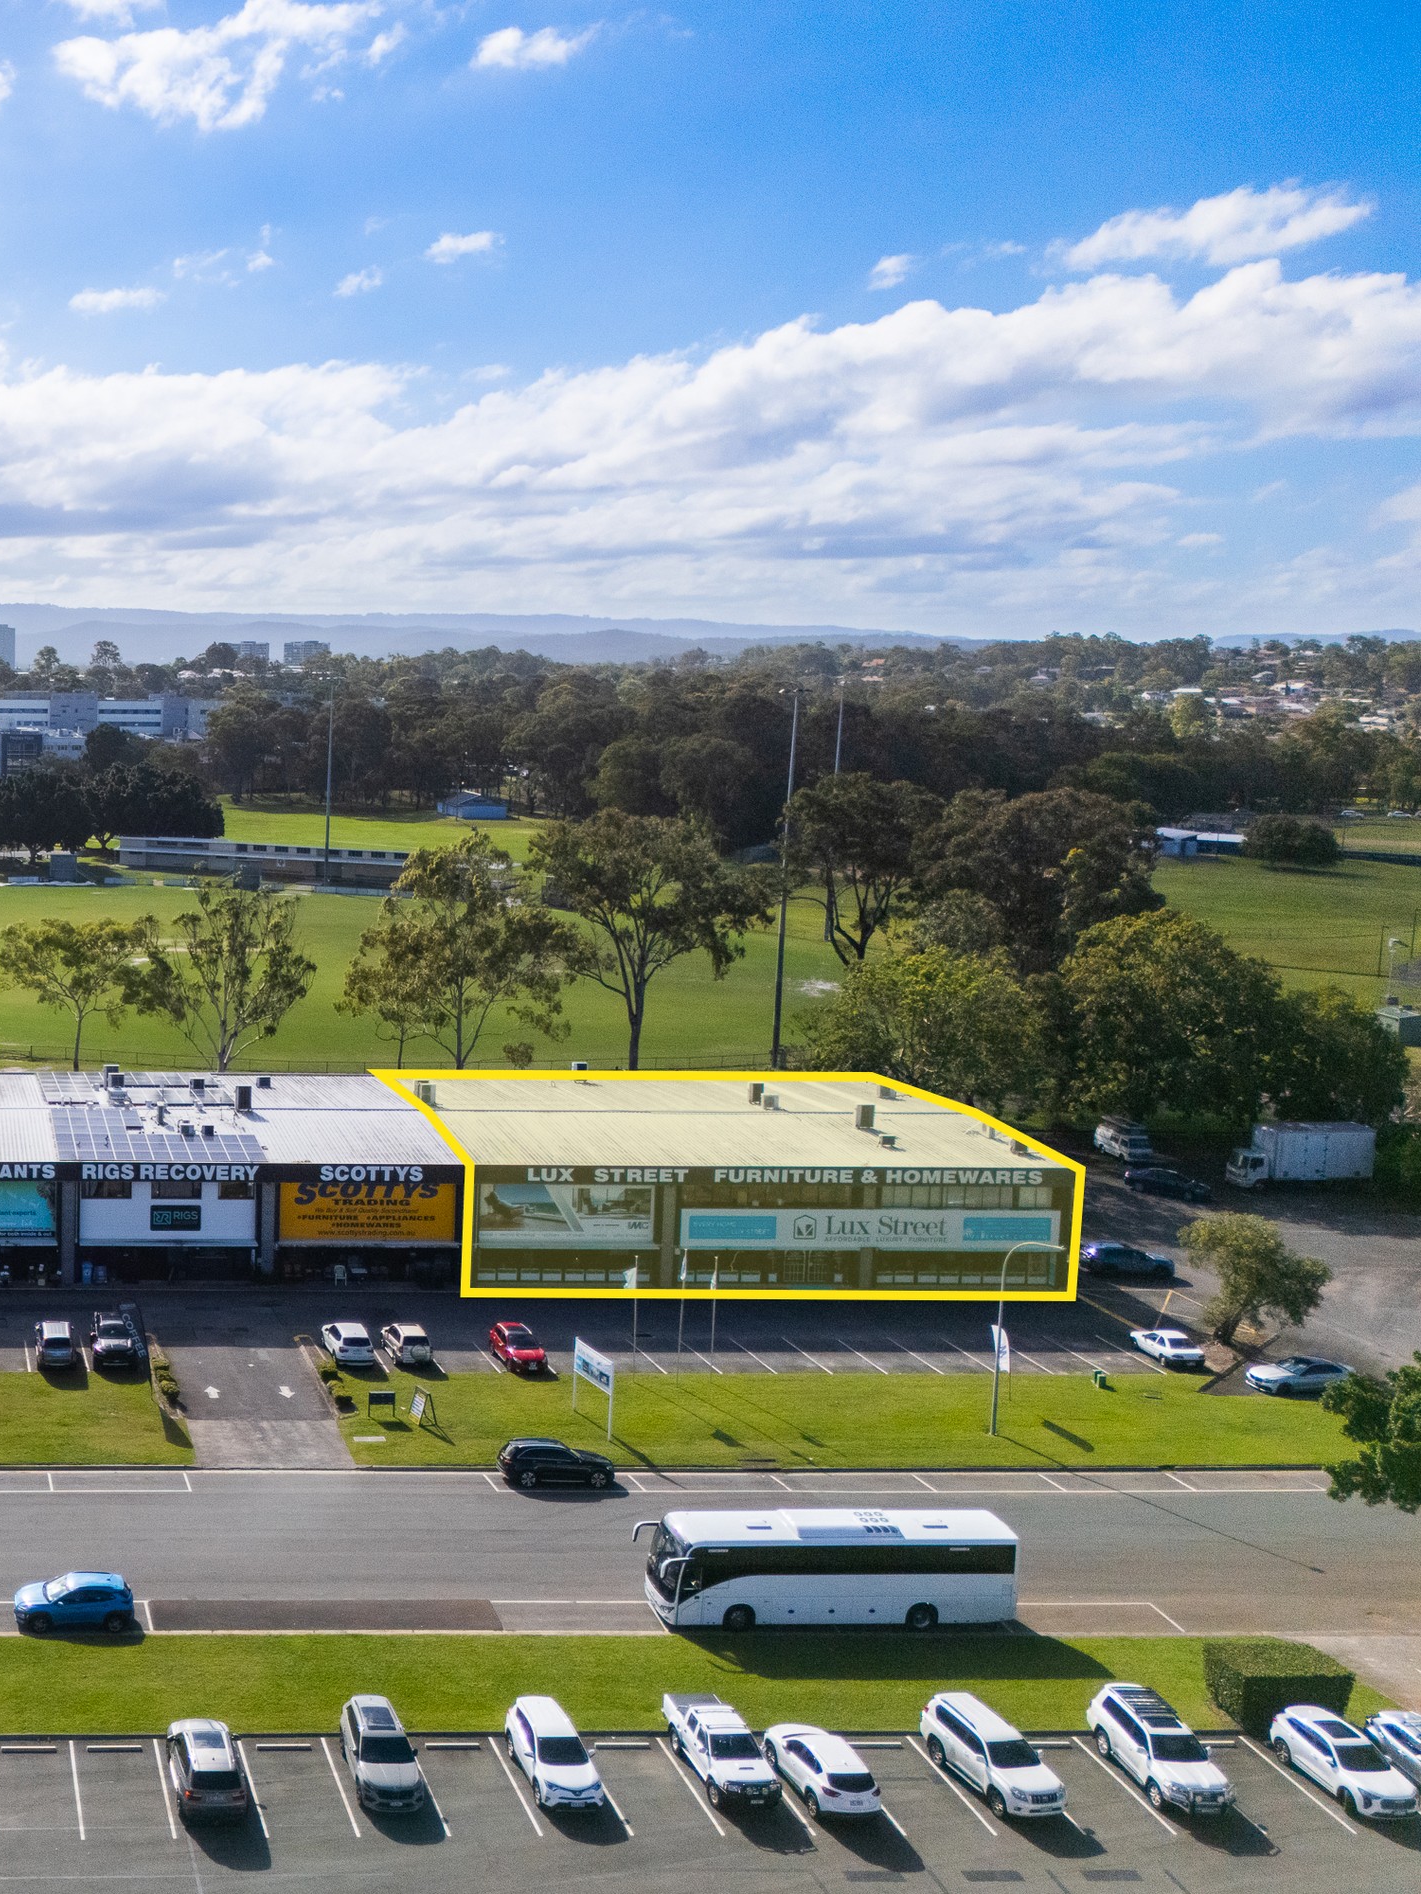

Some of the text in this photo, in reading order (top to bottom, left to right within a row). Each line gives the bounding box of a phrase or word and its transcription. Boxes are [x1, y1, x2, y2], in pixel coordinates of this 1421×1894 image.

[82, 1164, 259, 1181] RIGS RECOVERY
[319, 1165, 423, 1182] SCOTTYS
[527, 1167, 688, 1183] LUX STREET
[714, 1169, 1043, 1185] FURNITURE & HOMEWARES
[173, 1210, 198, 1220] RIGS
[825, 1215, 948, 1236] Lux Street
[122, 1313, 147, 1358] COFFEE
